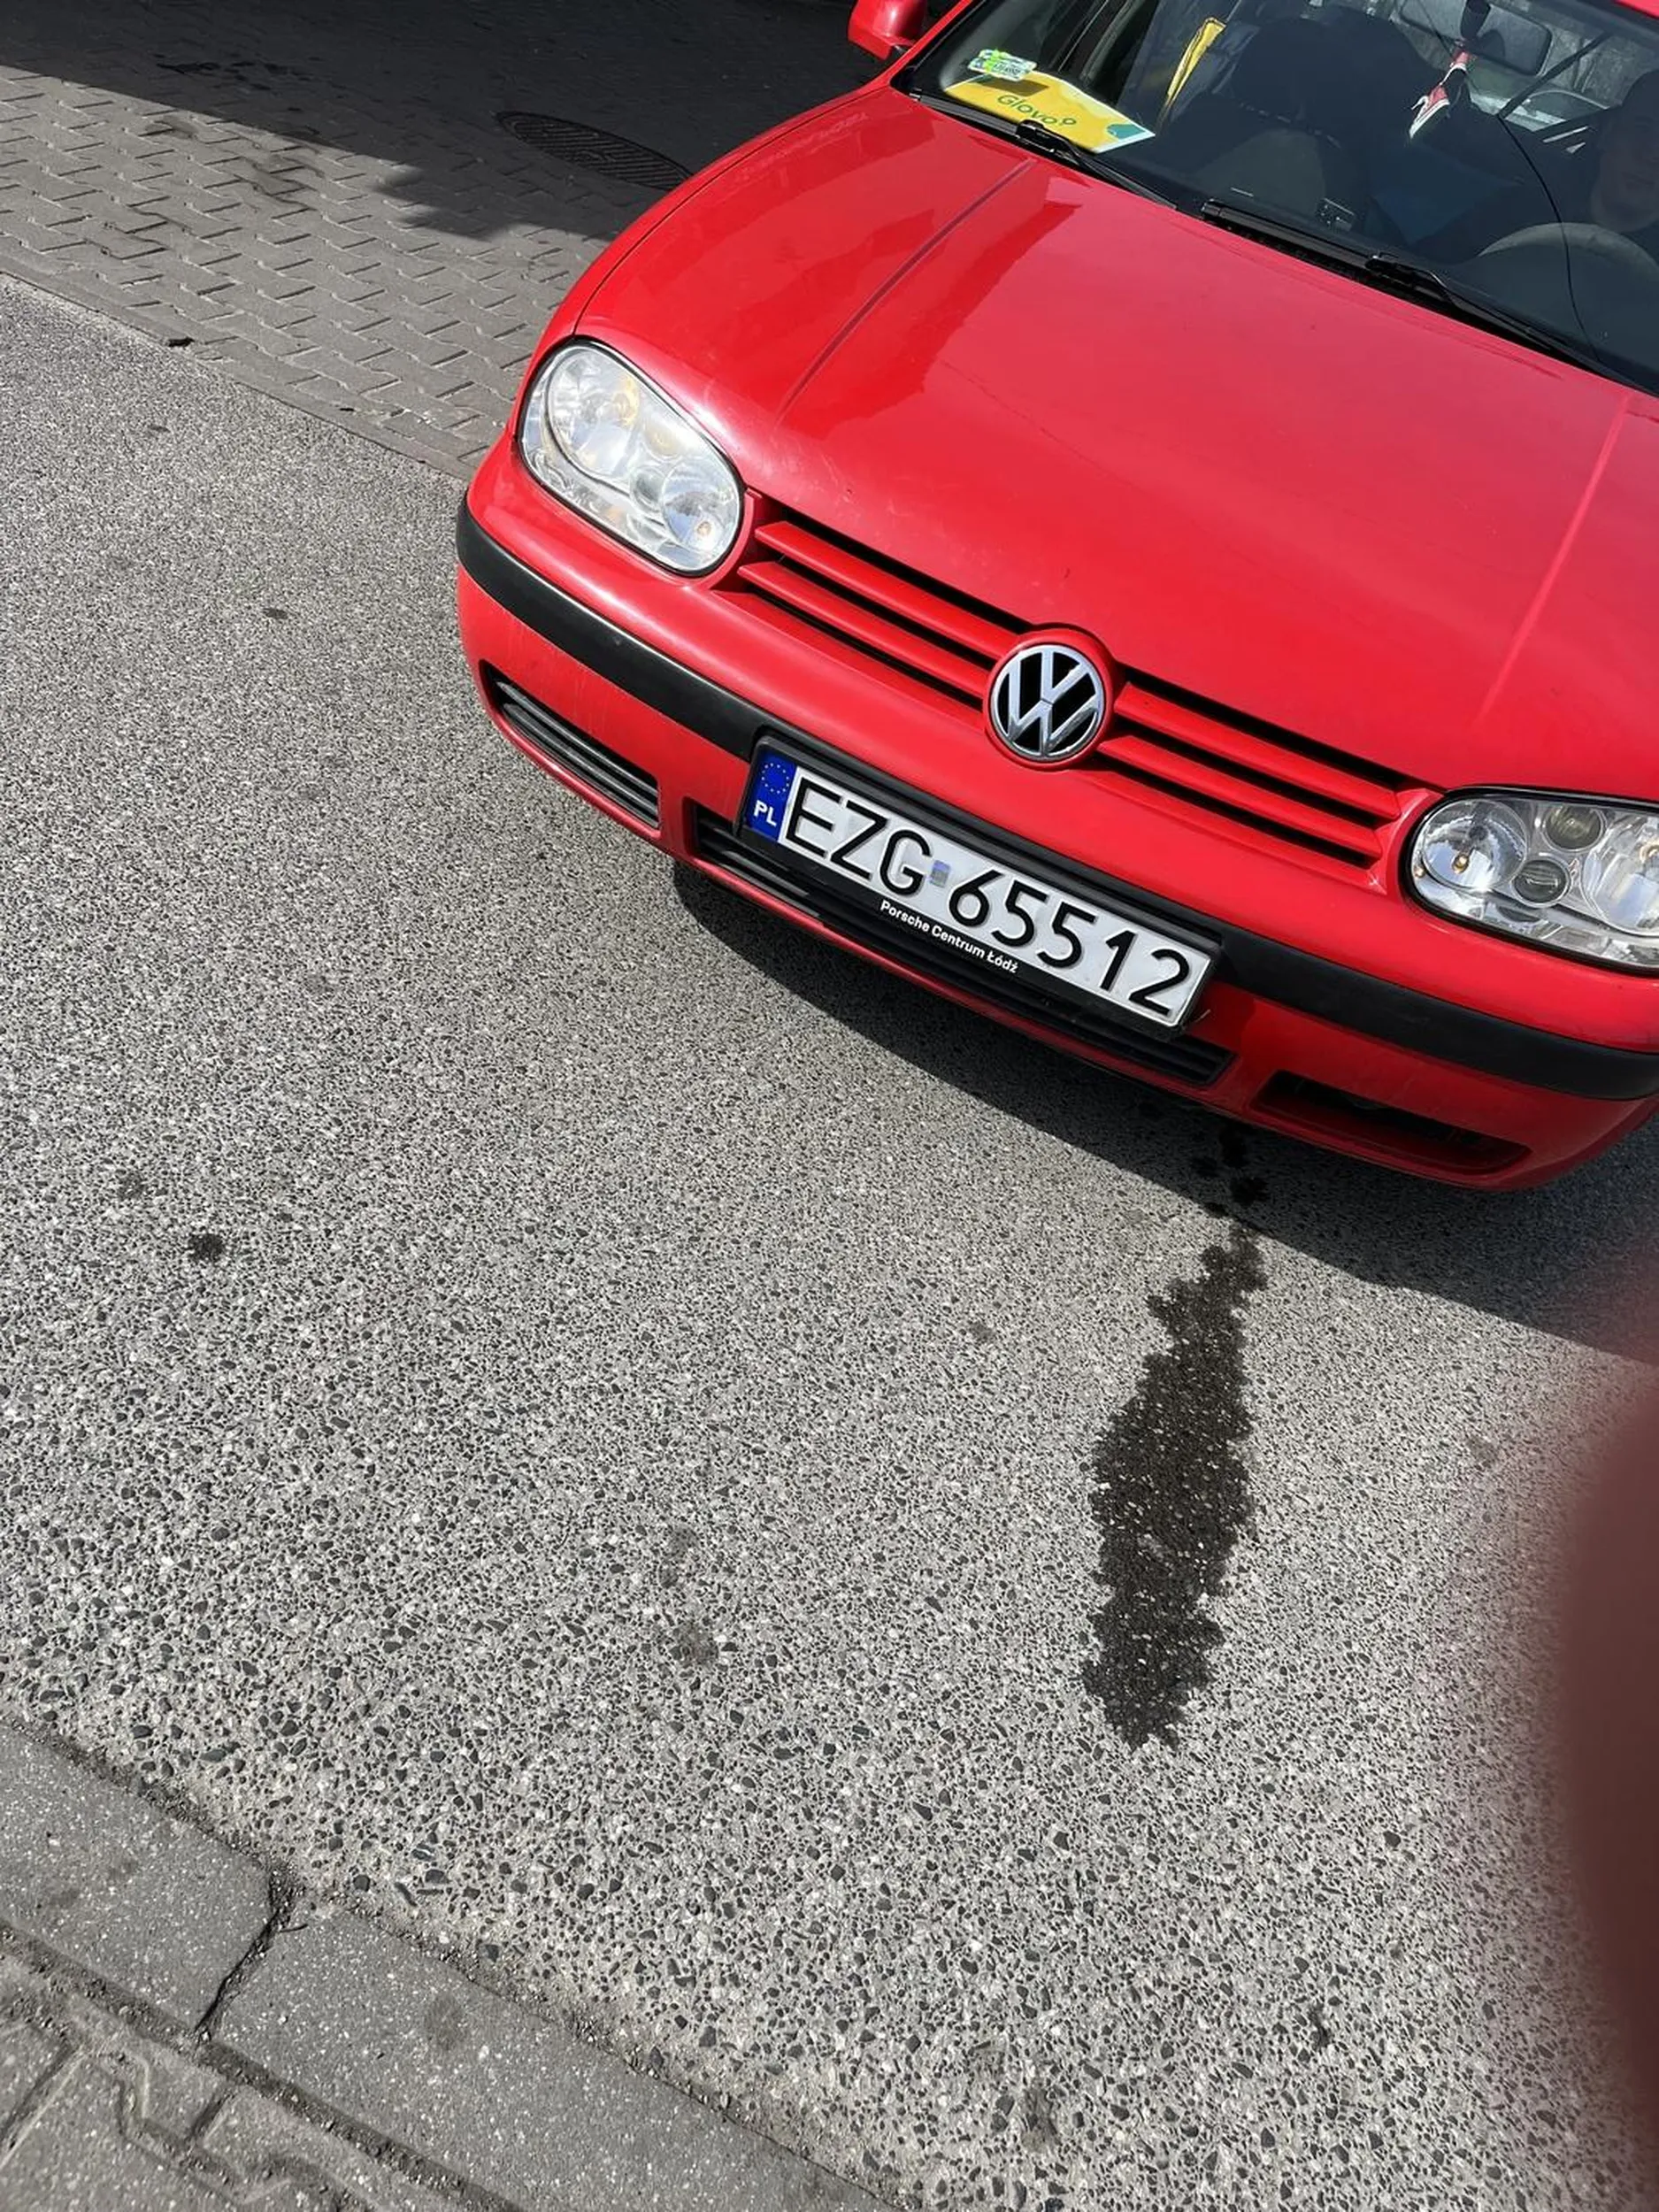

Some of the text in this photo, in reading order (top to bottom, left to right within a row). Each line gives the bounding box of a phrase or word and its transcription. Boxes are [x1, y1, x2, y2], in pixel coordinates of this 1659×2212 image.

[992, 645, 1104, 760] VW
[753, 800, 778, 828] PL
[785, 776, 1190, 1017] EZG 65512
[879, 899, 1018, 974] Porsche Centrum Łódź
